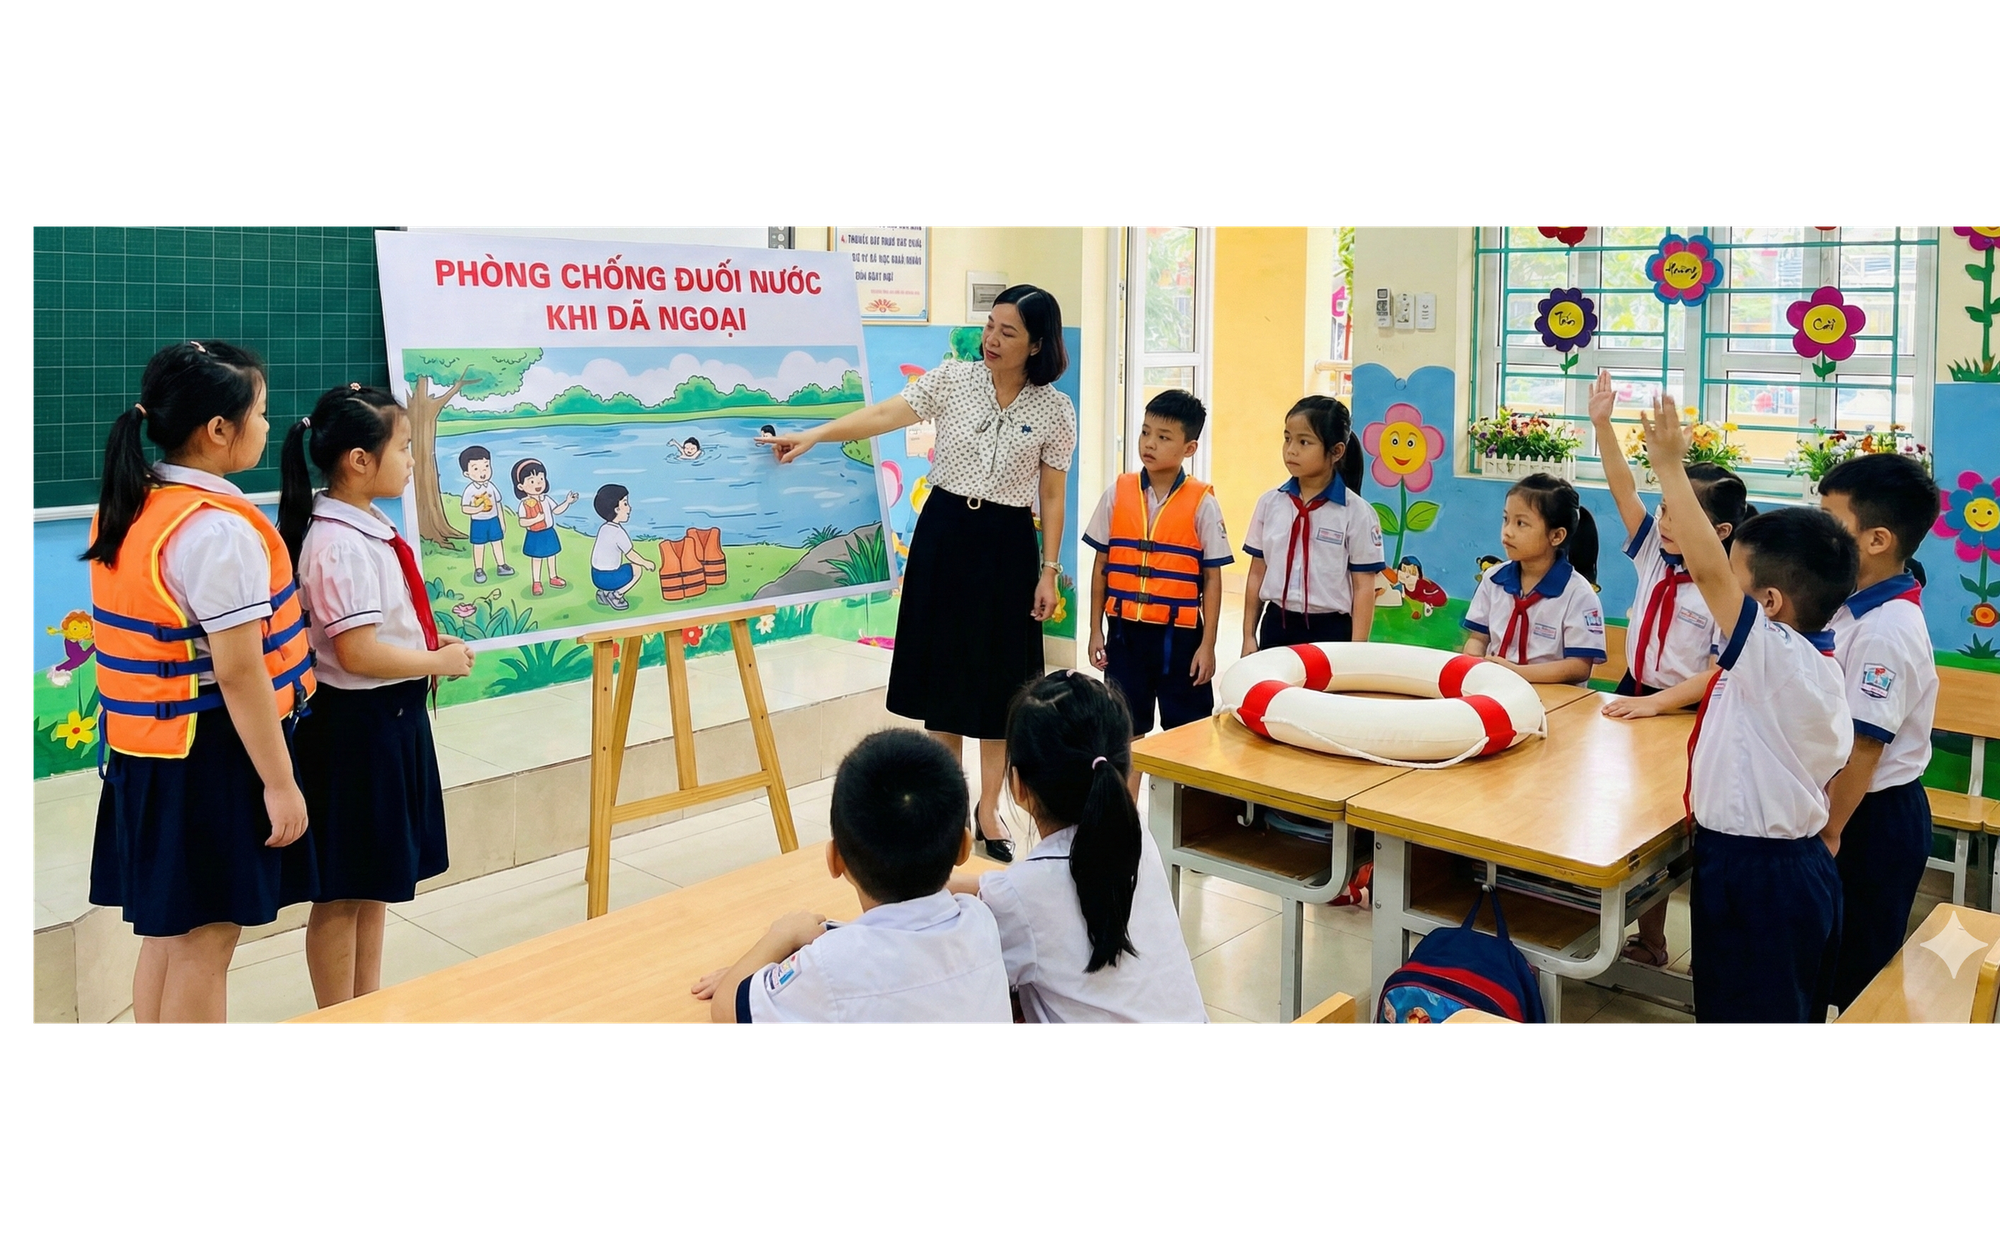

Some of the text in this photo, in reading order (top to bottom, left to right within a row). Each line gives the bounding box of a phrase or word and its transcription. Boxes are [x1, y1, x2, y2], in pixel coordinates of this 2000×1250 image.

[435, 253, 822, 295] PHÒNG CHỐNG ĐUỐI NƯỚC
[546, 299, 747, 338] KHI DÃ NGOẠI
